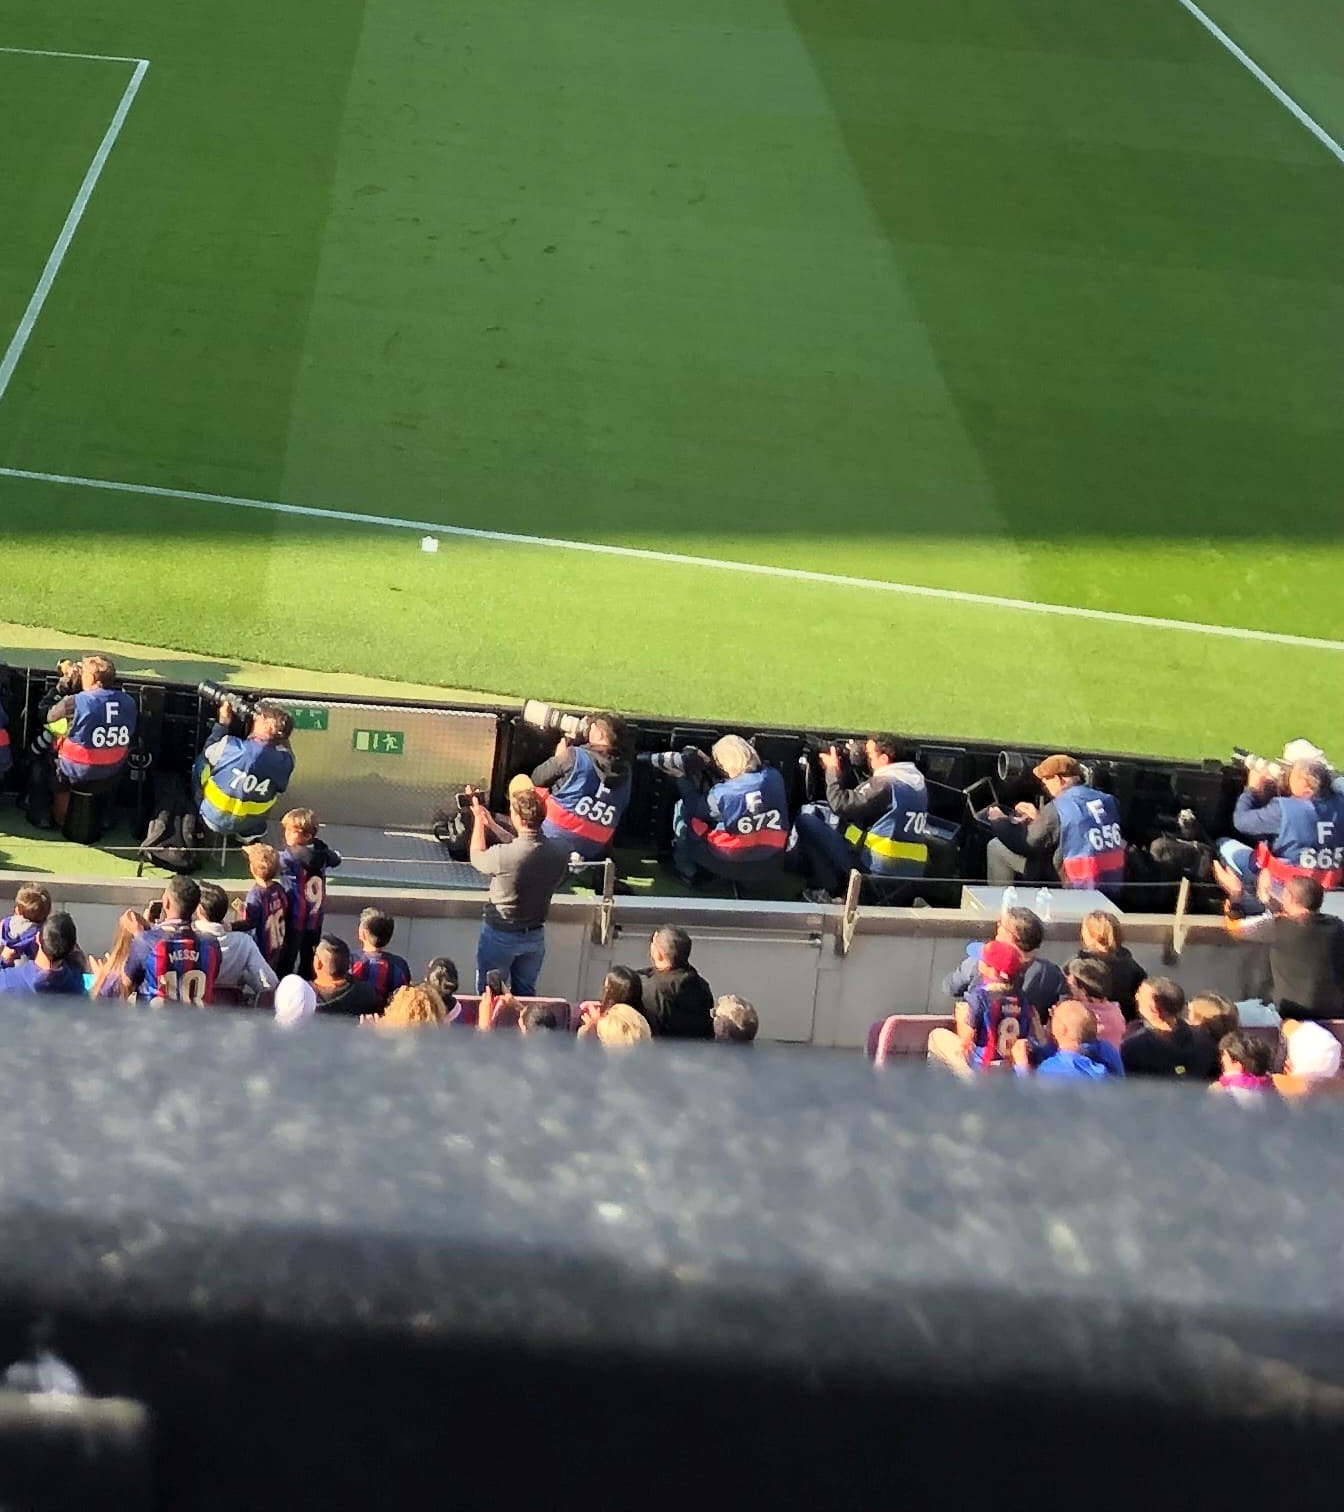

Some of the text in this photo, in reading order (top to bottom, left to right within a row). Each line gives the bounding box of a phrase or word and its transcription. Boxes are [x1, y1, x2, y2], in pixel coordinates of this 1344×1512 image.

[104, 701, 120, 724] F
[91, 725, 130, 748] 658
[228, 766, 272, 796] 704
[574, 795, 617, 826] 655
[744, 789, 763, 815] F
[1085, 797, 1108, 826] F
[736, 808, 782, 834] 672
[1315, 821, 1336, 846] F
[1087, 822, 1123, 852] 656
[167, 949, 200, 964] MESSI
